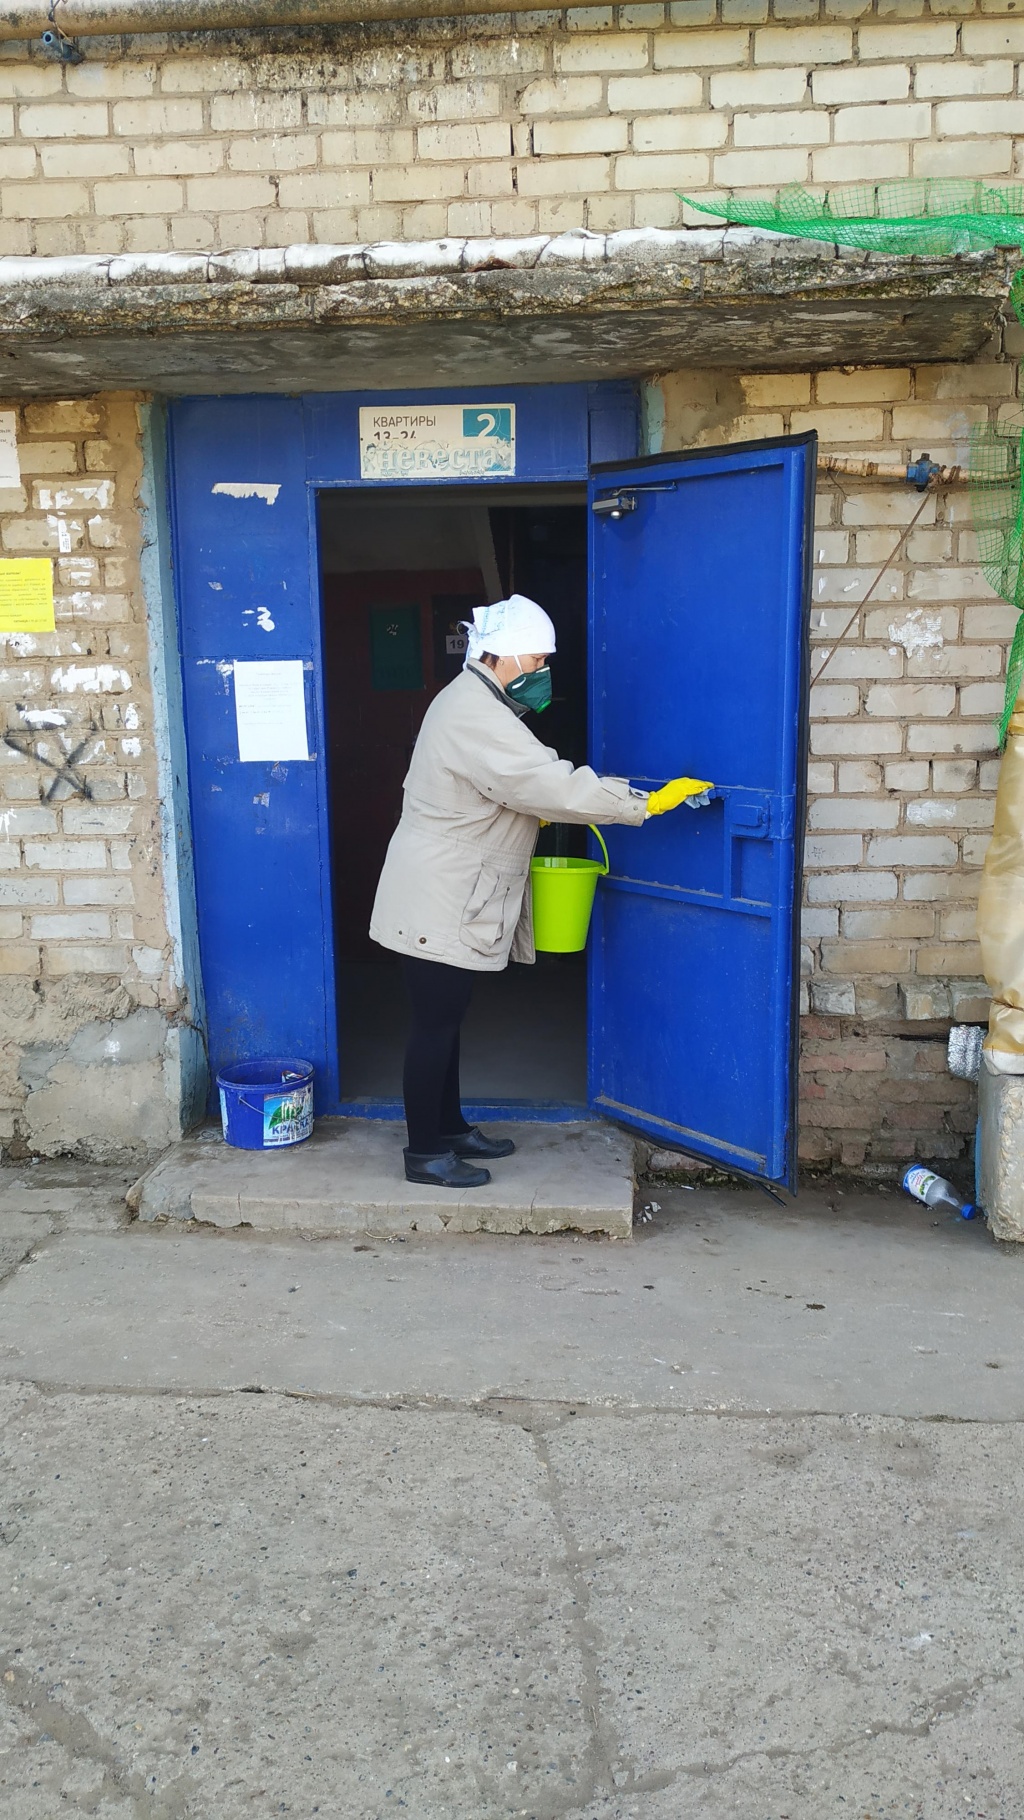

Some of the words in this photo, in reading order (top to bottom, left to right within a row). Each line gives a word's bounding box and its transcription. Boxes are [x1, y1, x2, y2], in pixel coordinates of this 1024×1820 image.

[373, 416, 436, 428] КВАРТИРЫ
[477, 413, 496, 438] 2
[450, 639, 464, 649] 19
